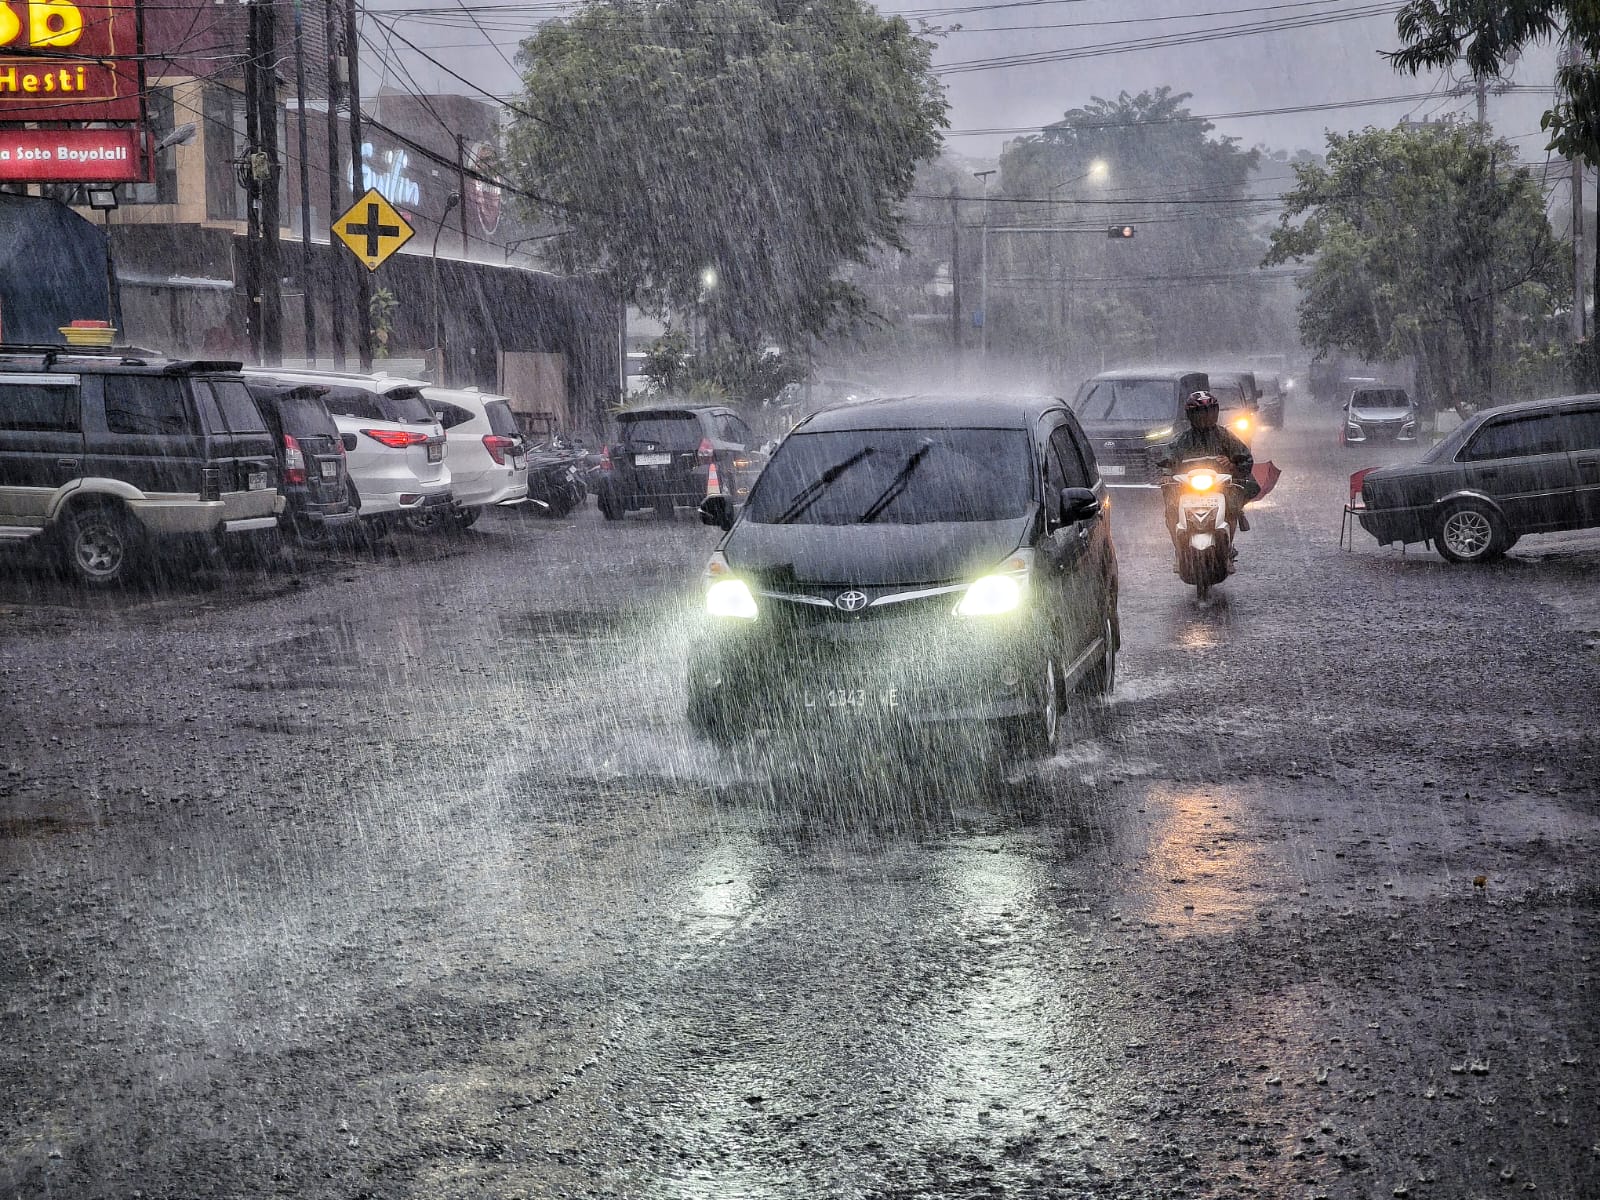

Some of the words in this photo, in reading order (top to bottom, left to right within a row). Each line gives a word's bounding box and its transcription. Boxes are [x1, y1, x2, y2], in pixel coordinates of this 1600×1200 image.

[0, 66, 86, 92] Hesti
[16, 146, 52, 160] Soto
[57, 146, 127, 162] Boyolali
